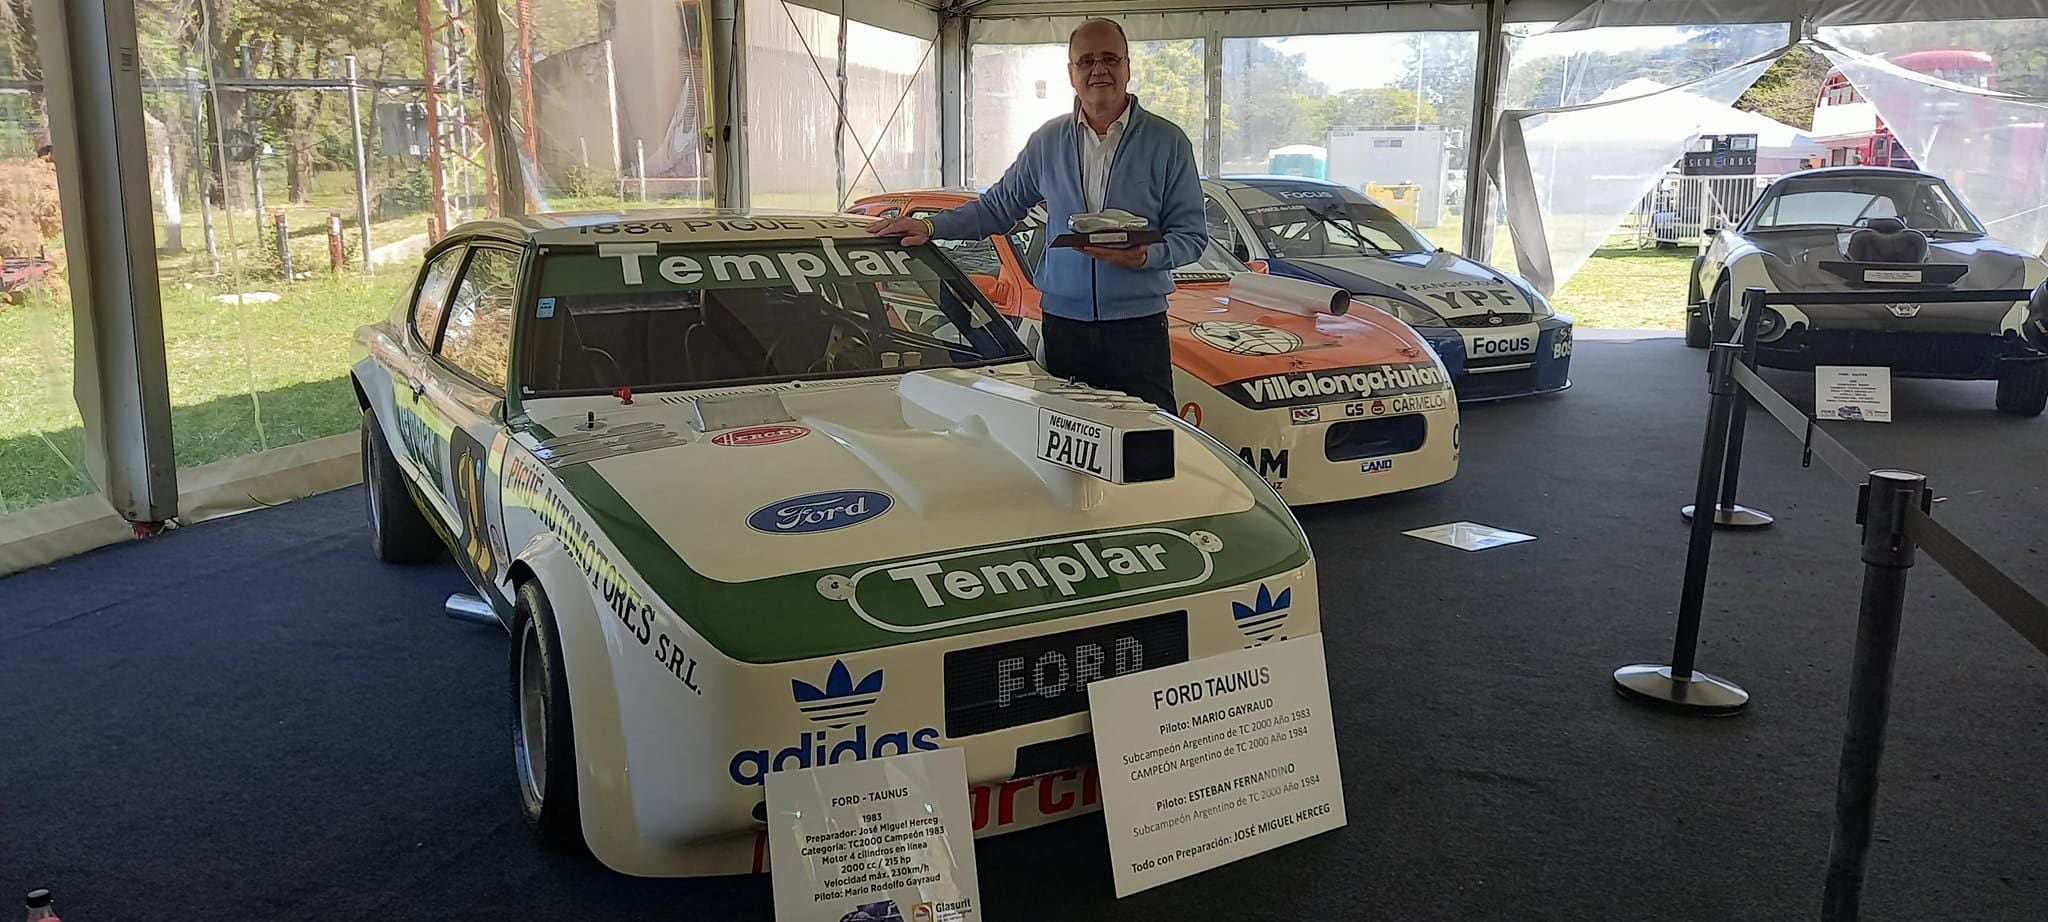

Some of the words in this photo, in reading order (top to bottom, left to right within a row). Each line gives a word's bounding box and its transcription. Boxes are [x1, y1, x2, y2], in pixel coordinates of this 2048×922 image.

[597, 236, 913, 293] Templar
[1427, 289, 1515, 309] YPF
[1473, 337, 1530, 354] Focus
[1345, 403, 1364, 417] GS
[1393, 395, 1443, 412] CARMELO
[1049, 415, 1101, 438] NEUMATICOS
[1045, 430, 1102, 474] PAUL
[776, 496, 870, 529] Ford
[539, 486, 656, 645] AUTOMOTORES
[655, 633, 702, 695] S.R.L.
[887, 542, 1167, 608] Templar
[998, 636, 1143, 707] FORD
[1153, 682, 1203, 711] FORD
[1205, 666, 1271, 697] TAUNUS
[1159, 719, 1190, 735] Piloto:
[1192, 710, 1226, 728] MARIO
[1228, 698, 1274, 718] GAYRAUD
[1123, 742, 1181, 766] Subcampeón
[1183, 732, 1225, 750] Argentino
[1226, 727, 1238, 738] de
[1239, 724, 1250, 735] TC
[1251, 718, 1273, 733] 2000
[1273, 713, 1290, 726] Año
[1291, 708, 1311, 722] 1983
[729, 725, 940, 787] adidas
[1130, 759, 1178, 781] CAMPEÓN
[1180, 750, 1222, 769] Argentino
[1223, 745, 1235, 756] de
[1236, 742, 1247, 753] TC
[1248, 736, 1270, 750] 2000
[1270, 731, 1287, 744] Año
[1288, 726, 1308, 740] 1984
[832, 795, 860, 808] FORD
[868, 788, 909, 802] TAUNUS
[1156, 795, 1187, 811] Piloto:
[1188, 781, 1232, 802] ESTEBAN
[1233, 763, 1296, 789] FERNANDINO
[862, 813, 882, 823] 1983
[1133, 814, 1191, 838] Subcampeón
[1193, 801, 1235, 820] Argentino
[1236, 796, 1248, 807] de
[1248, 793, 1260, 804] TC
[1261, 787, 1282, 801] 2000
[1283, 781, 1299, 795] Año
[1301, 774, 1320, 789] 1984
[801, 842, 847, 857] Categoría:
[848, 837, 883, 849] TC2000
[884, 831, 924, 844] Campeón
[926, 826, 945, 836] 1983
[806, 830, 856, 844] Preparador:
[859, 826, 878, 836] José
[880, 820, 908, 833] Miguel
[910, 817, 939, 829] Herceg
[1131, 859, 1155, 873] Todo
[1157, 853, 1174, 865] con
[1176, 835, 1232, 860] Preparación:
[1233, 822, 1257, 842] JOSÉ
[1258, 813, 1295, 834] MIGUEL
[1296, 802, 1331, 824] HERCEG
[822, 854, 847, 865] Motor
[849, 852, 856, 861] 4
[857, 847, 894, 859] cilindros
[895, 845, 906, 853] en
[907, 841, 928, 852] línea
[841, 863, 865, 874] 2000
[866, 862, 877, 870] cc
[884, 856, 899, 867] 215
[900, 855, 911, 866] hp
[814, 890, 843, 902] Piloto:
[844, 886, 869, 897] Mario
[871, 879, 905, 893] Rodolfo
[906, 873, 941, 888] Gayraud
[824, 873, 867, 888] Velocidad
[868, 870, 890, 882] máx.
[891, 864, 930, 879] 230km/h
[935, 898, 972, 913] Glasurit
